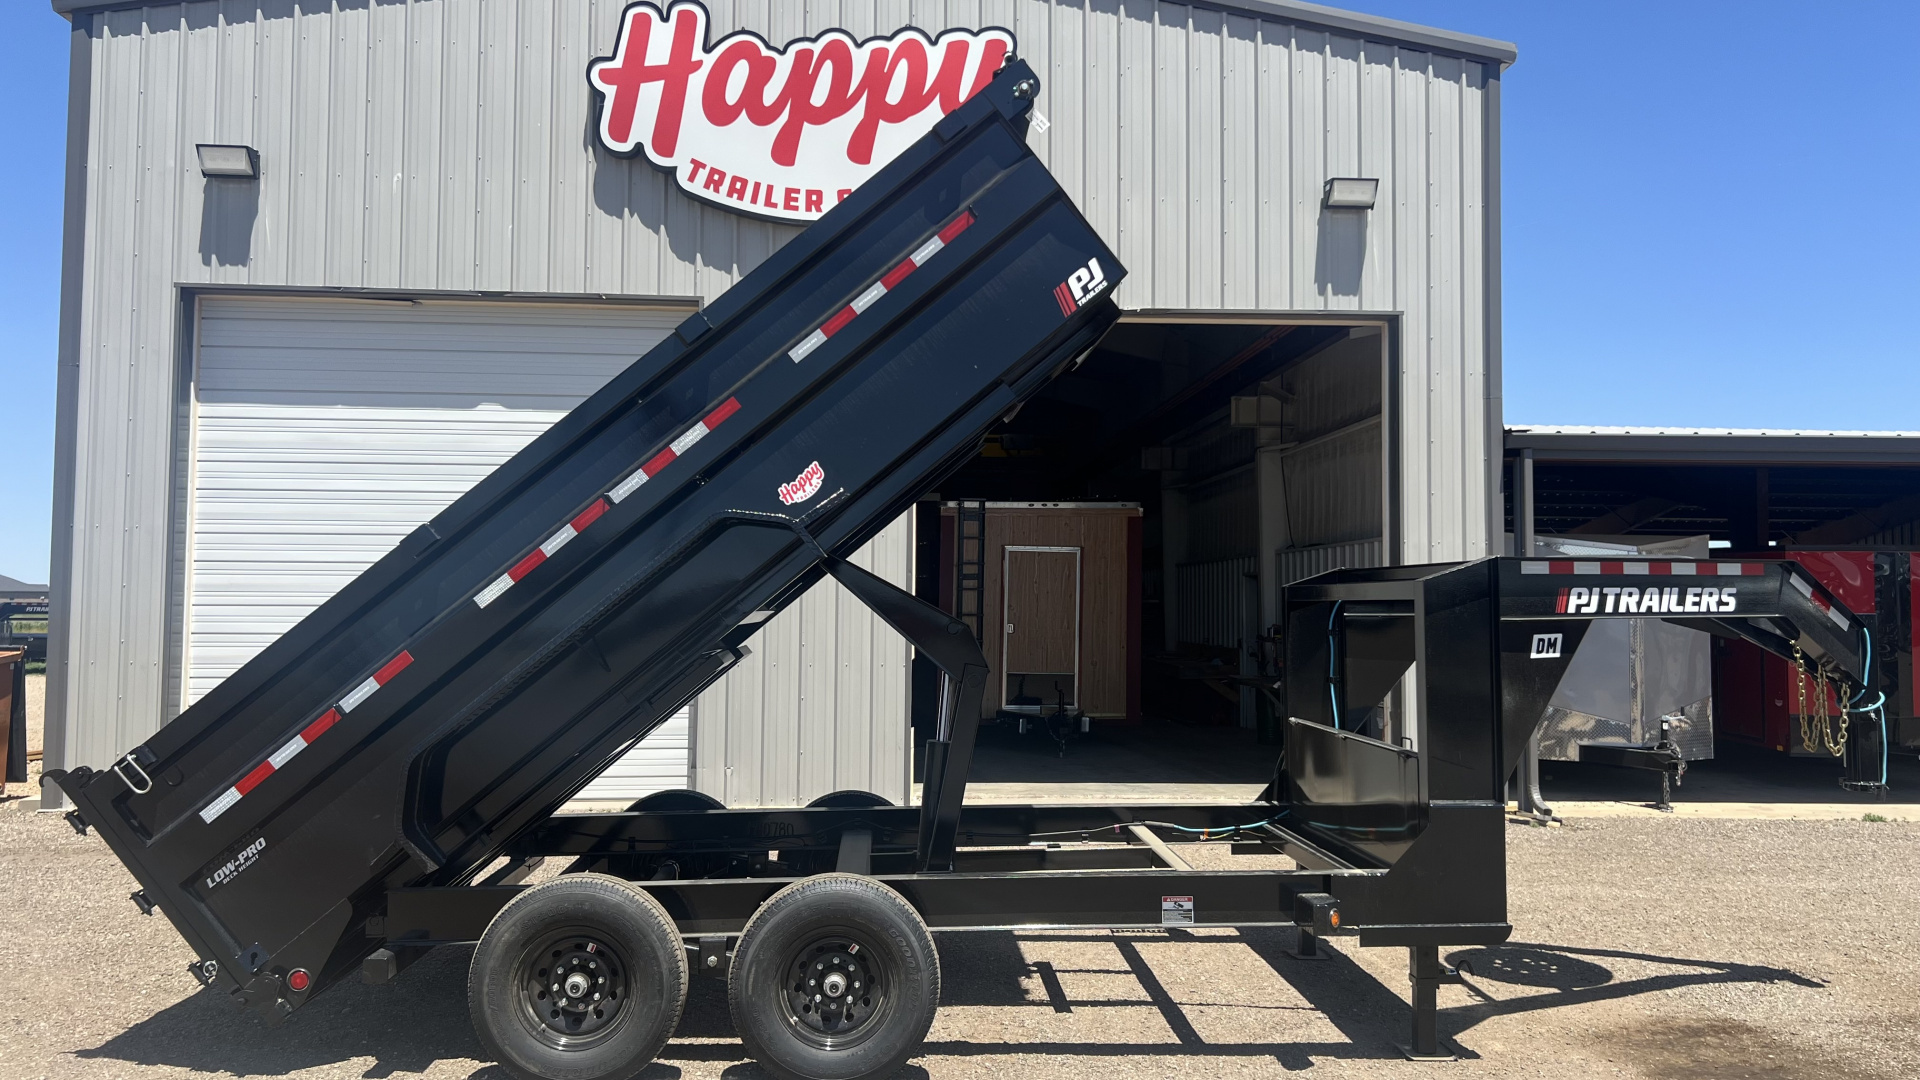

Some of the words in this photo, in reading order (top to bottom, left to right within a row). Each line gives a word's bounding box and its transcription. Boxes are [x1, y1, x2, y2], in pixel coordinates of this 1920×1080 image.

[686, 157, 824, 213] TRAILER
[1067, 257, 1105, 301] PJ
[1076, 280, 1108, 307] TRAILERS
[779, 463, 823, 504] Happy
[1602, 587, 1737, 613] TRAILERS
[1536, 637, 1558, 655] DM
[206, 837, 267, 889] LOW-PRO
[222, 870, 238, 885] DECK
[238, 853, 260, 872] HEIGHT
